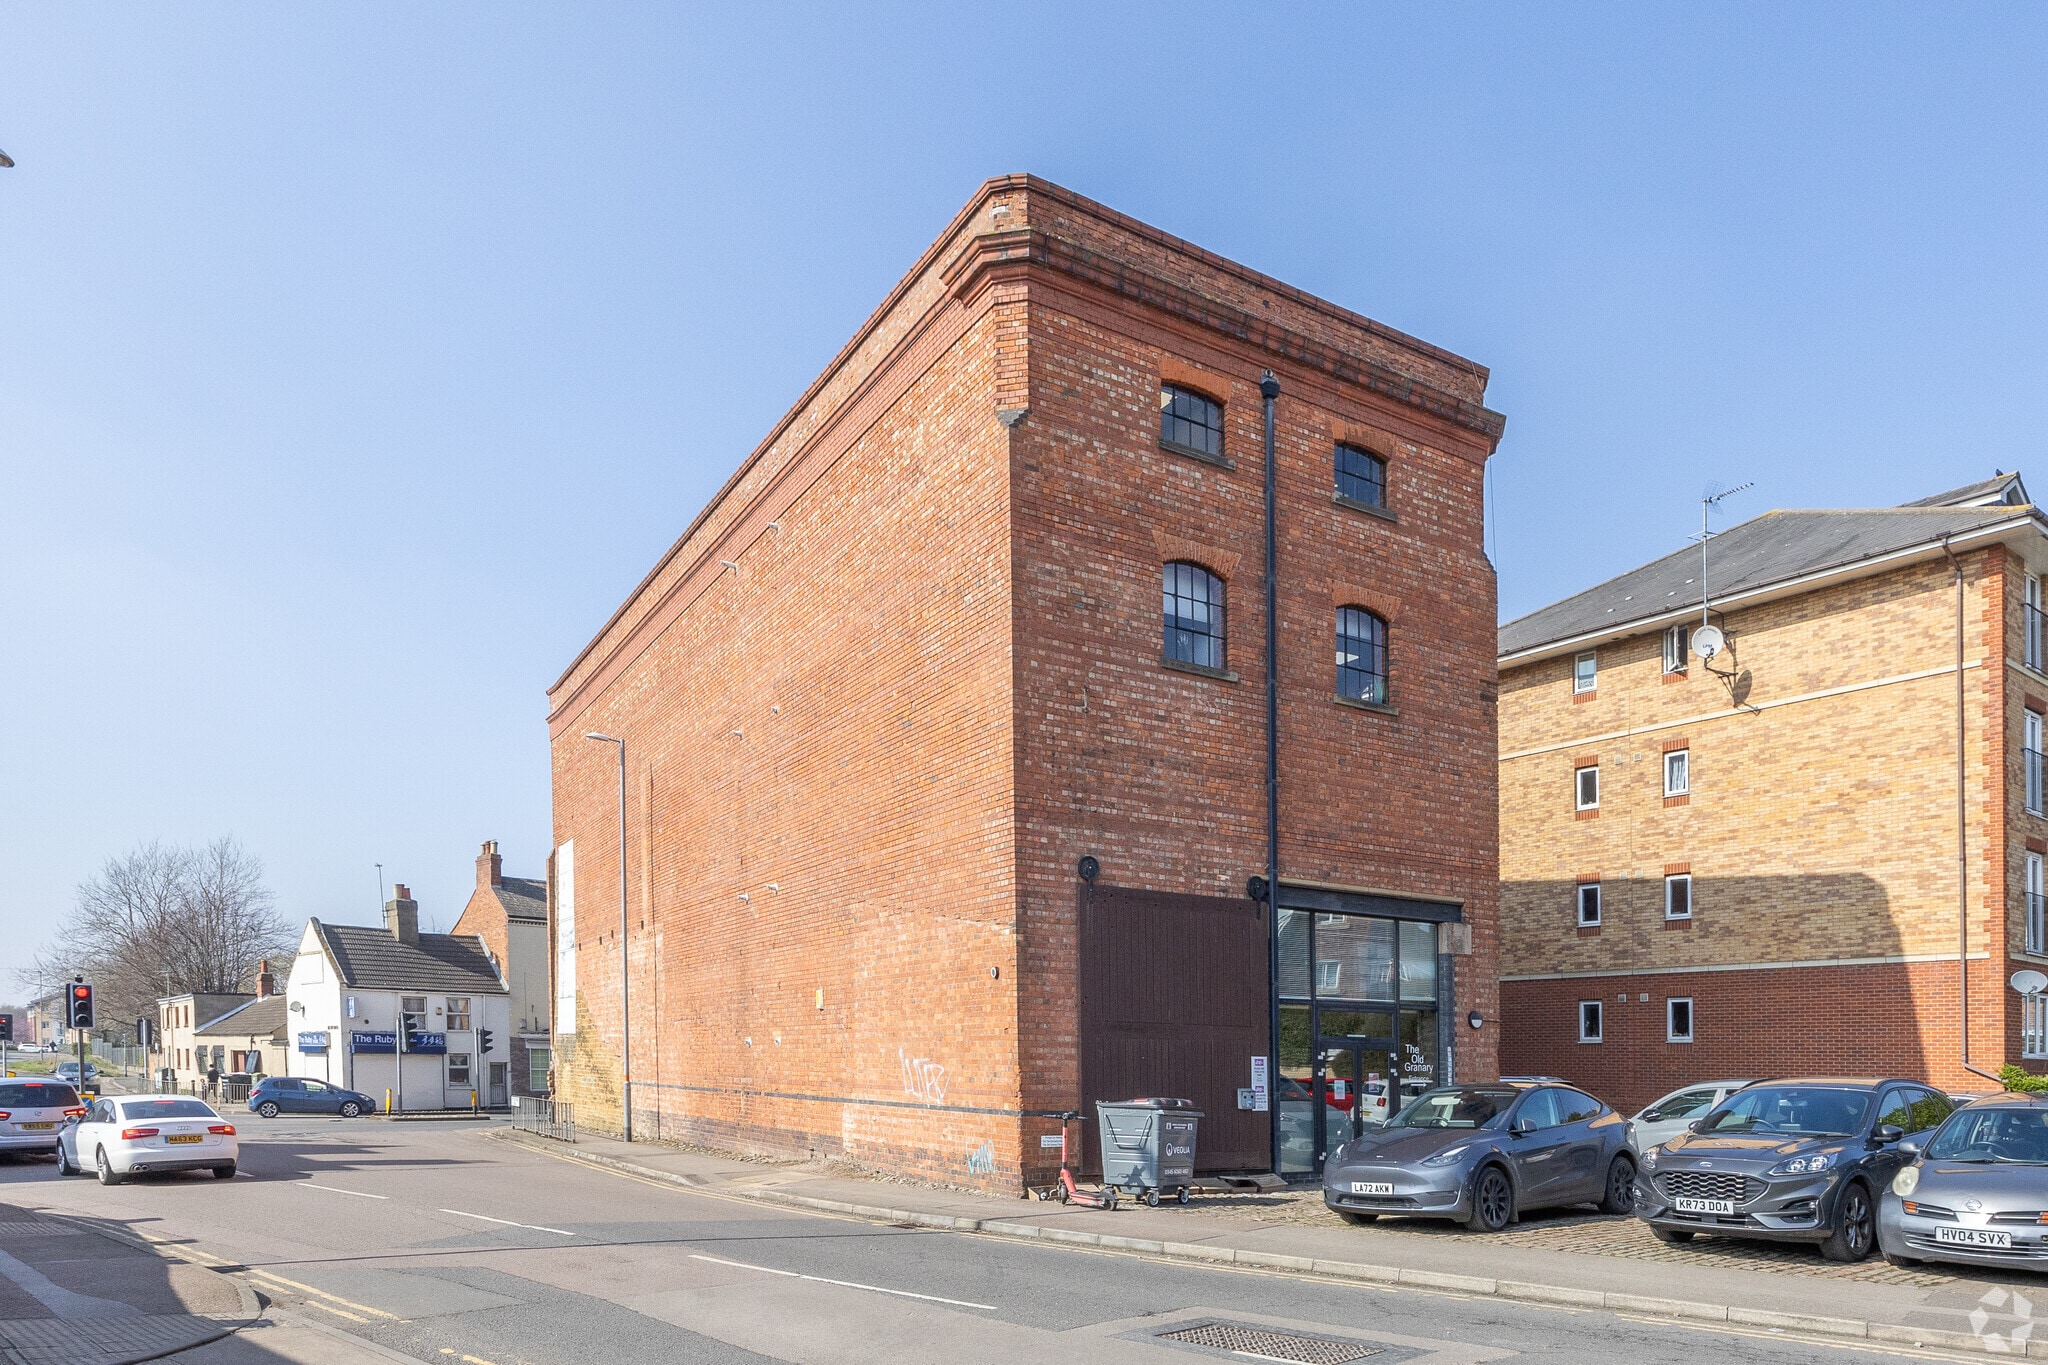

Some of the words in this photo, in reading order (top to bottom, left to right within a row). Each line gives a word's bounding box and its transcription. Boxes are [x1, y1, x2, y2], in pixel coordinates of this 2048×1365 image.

[354, 1034, 372, 1043] The
[374, 1034, 397, 1044] Ruby
[1405, 1044, 1420, 1054] The
[1411, 1054, 1424, 1064] Old
[1404, 1062, 1434, 1074] Granary
[1172, 1146, 1190, 1154] VEOLIA
[1354, 1184, 1373, 1193] LA72
[1375, 1184, 1389, 1193] AKW
[1680, 1199, 1706, 1210] KR73
[1708, 1201, 1729, 1212] DOA
[1942, 1229, 1974, 1242] HV04
[1979, 1232, 2005, 1245] SVX
